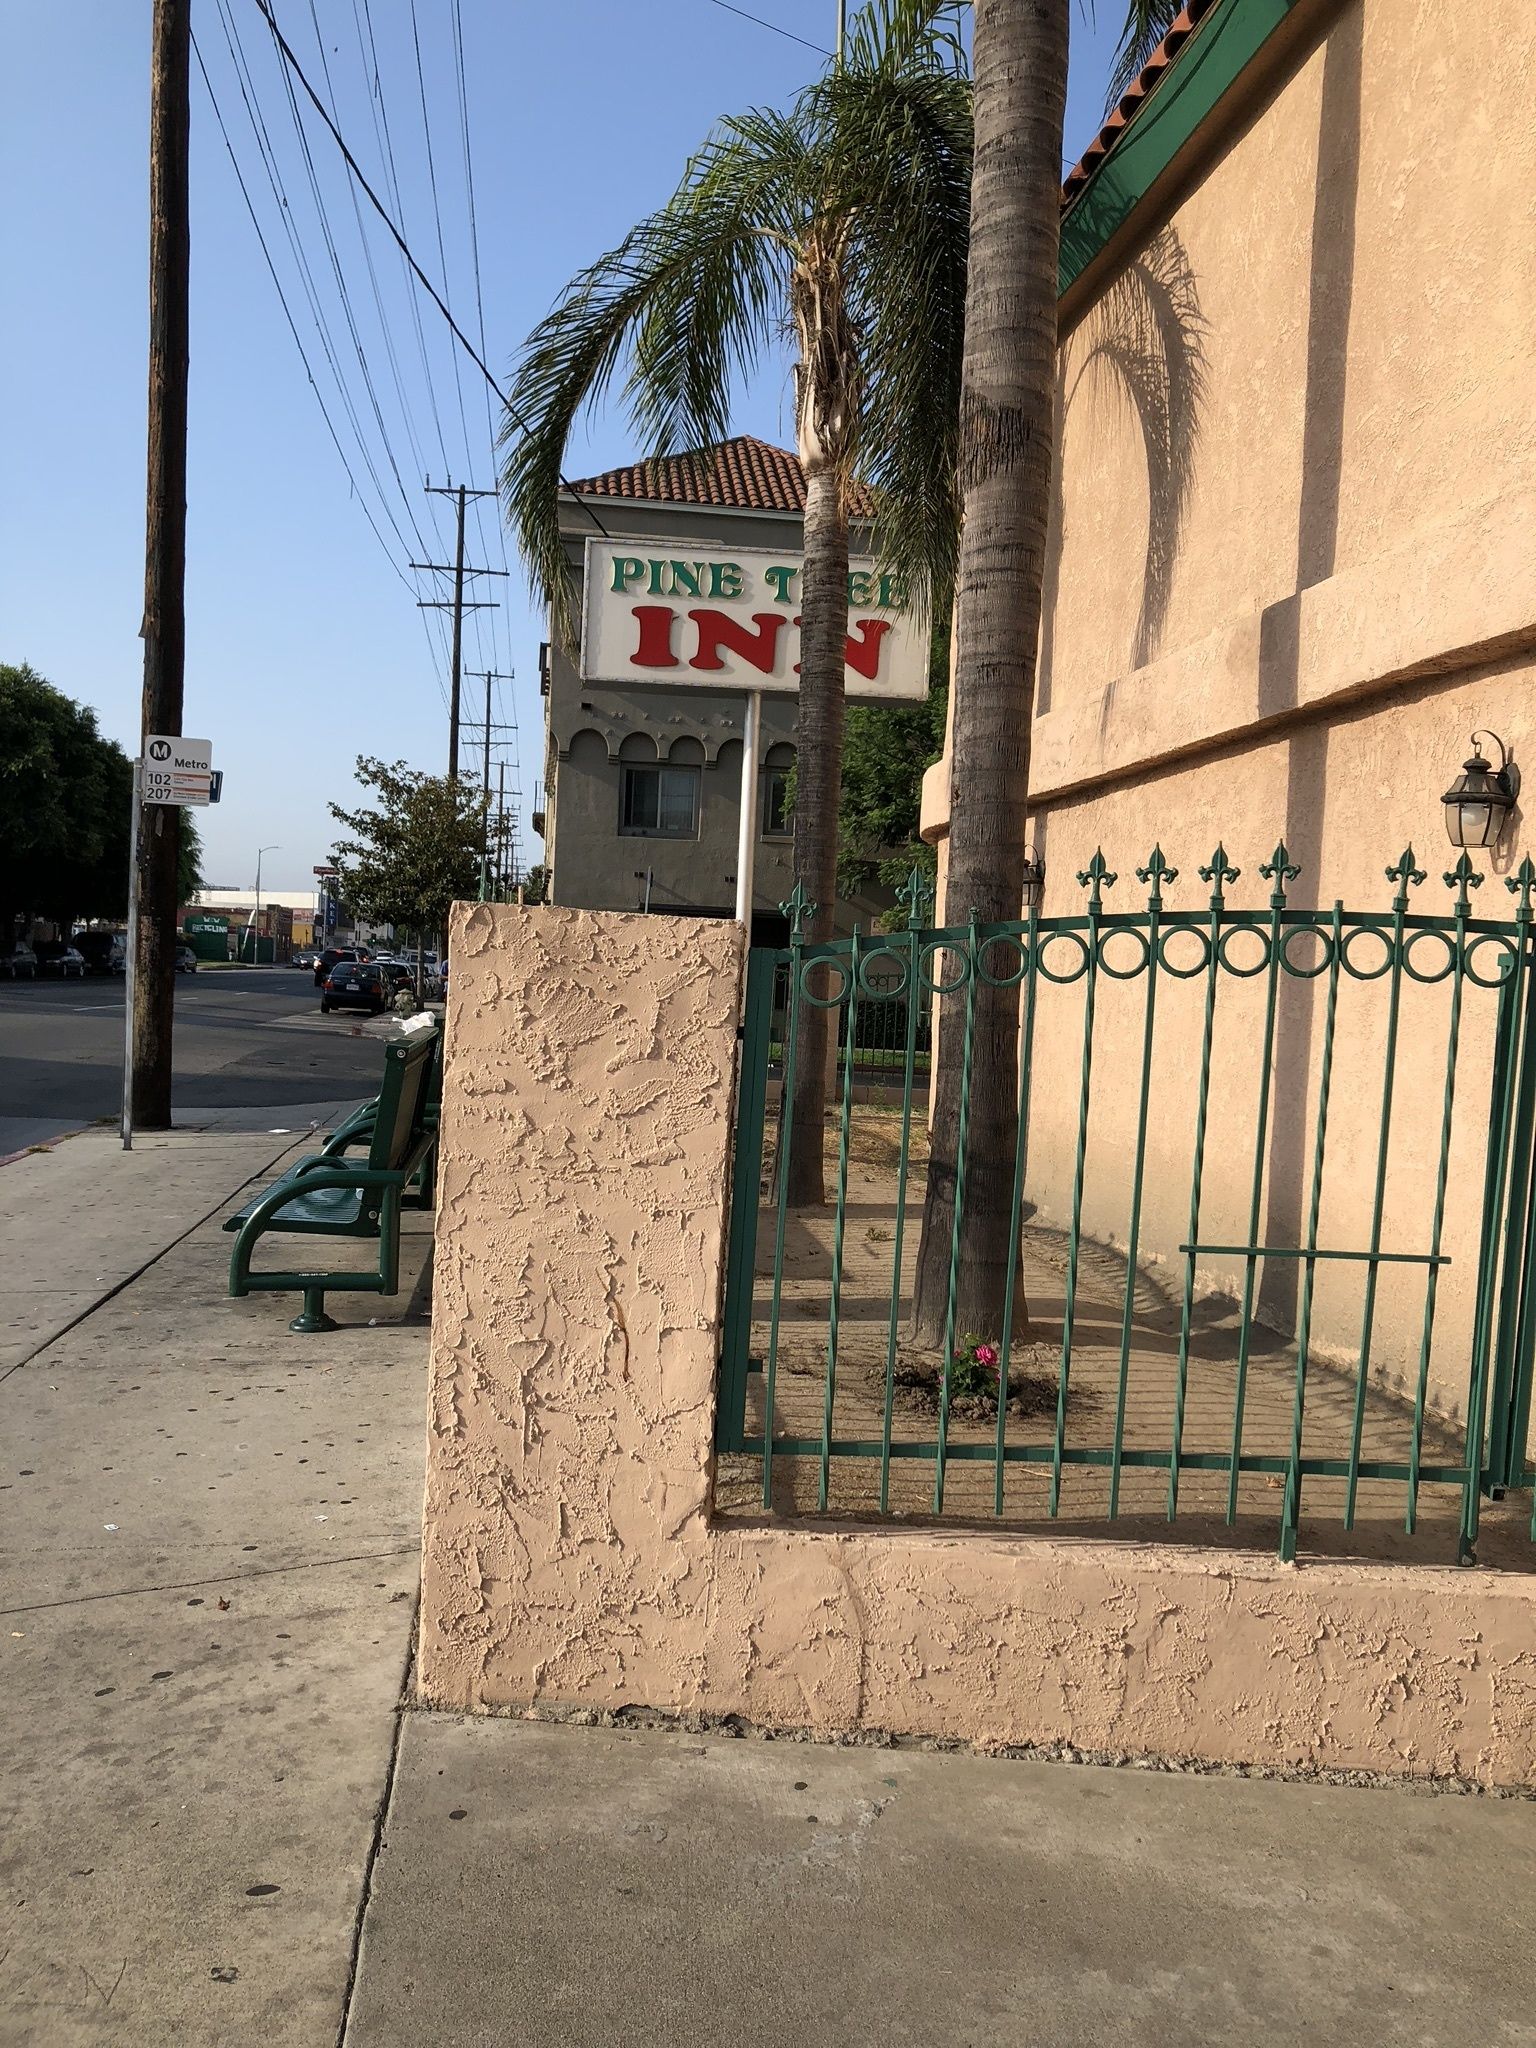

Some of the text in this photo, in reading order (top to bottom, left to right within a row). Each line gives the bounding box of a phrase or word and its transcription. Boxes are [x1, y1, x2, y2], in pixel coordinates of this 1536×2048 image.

[610, 555, 908, 608] PINE TEE
[174, 758, 208, 769] Metro
[148, 773, 171, 785] 102
[147, 787, 172, 799] 207
